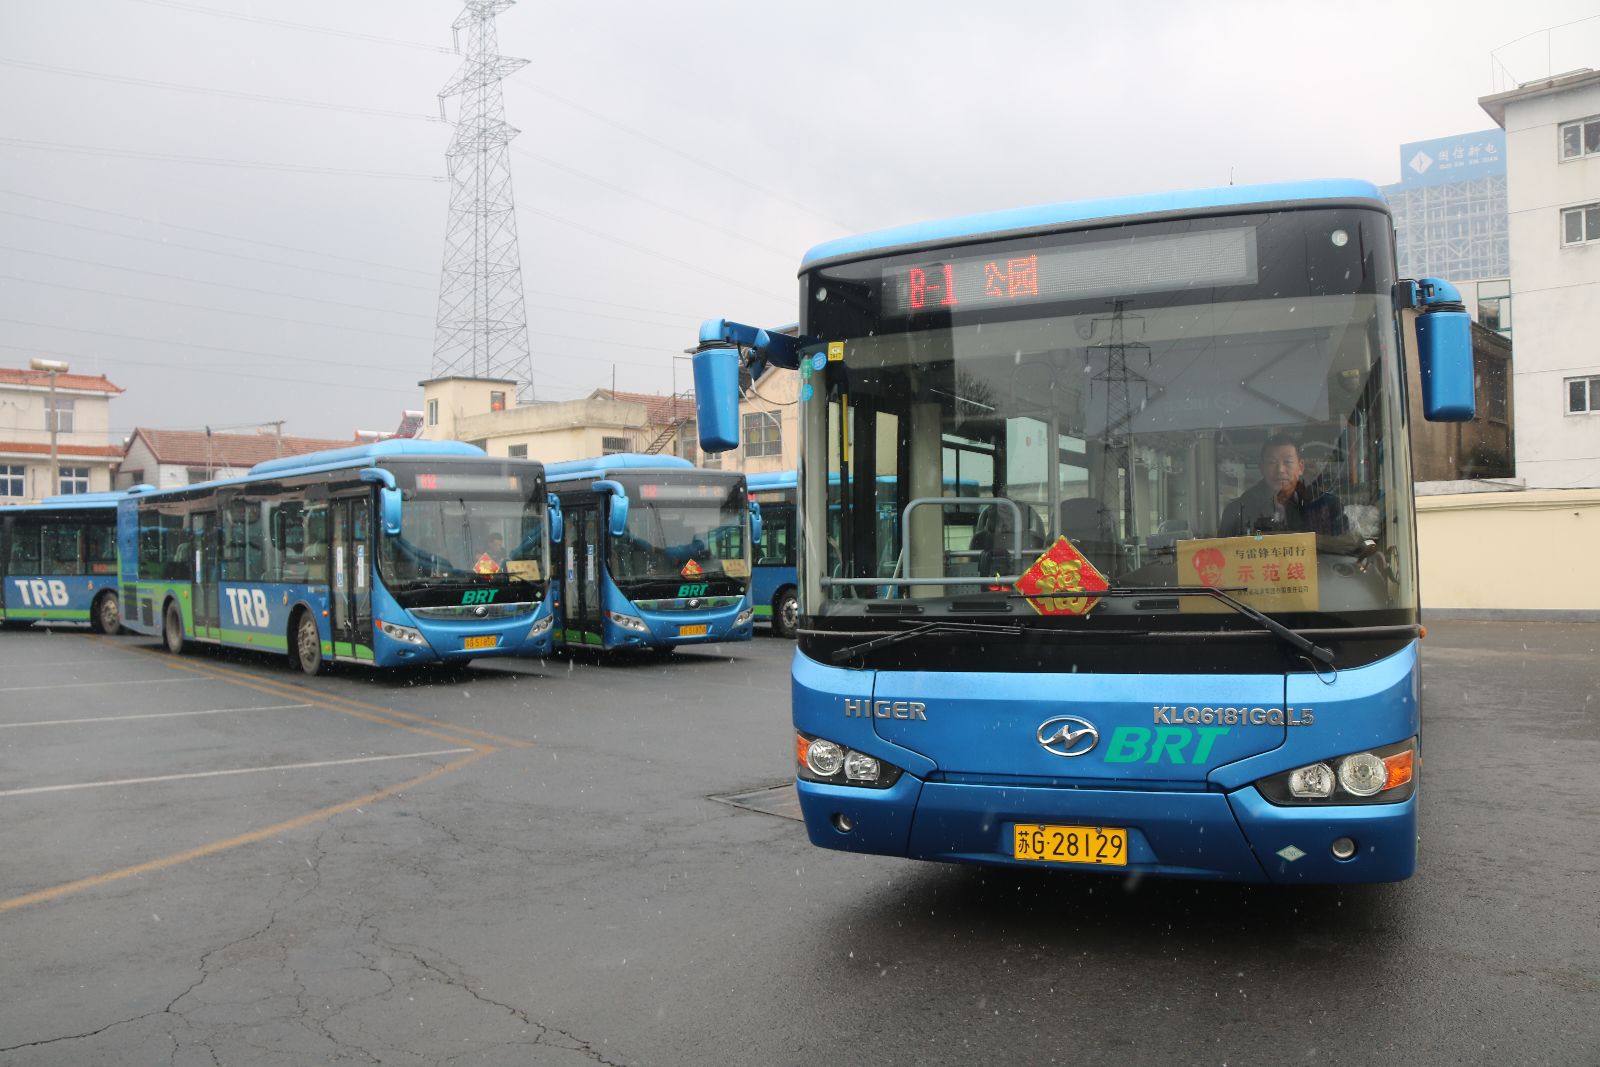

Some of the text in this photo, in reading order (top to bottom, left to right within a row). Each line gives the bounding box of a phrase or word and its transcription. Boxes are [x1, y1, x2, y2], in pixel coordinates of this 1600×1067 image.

[910, 255, 1039, 308] B-1 公园
[1236, 546, 1307, 560] 与雷锋车同行
[1237, 562, 1306, 582] 示范线
[14, 579, 70, 606] TRB
[462, 588, 500, 605] BRT
[677, 583, 710, 598] BRT
[1035, 558, 1087, 613] 福
[225, 588, 270, 628] TRB
[844, 698, 928, 722] HIGER
[1152, 706, 1314, 727] KLQ6181GQL5
[1104, 725, 1233, 765] BRT
